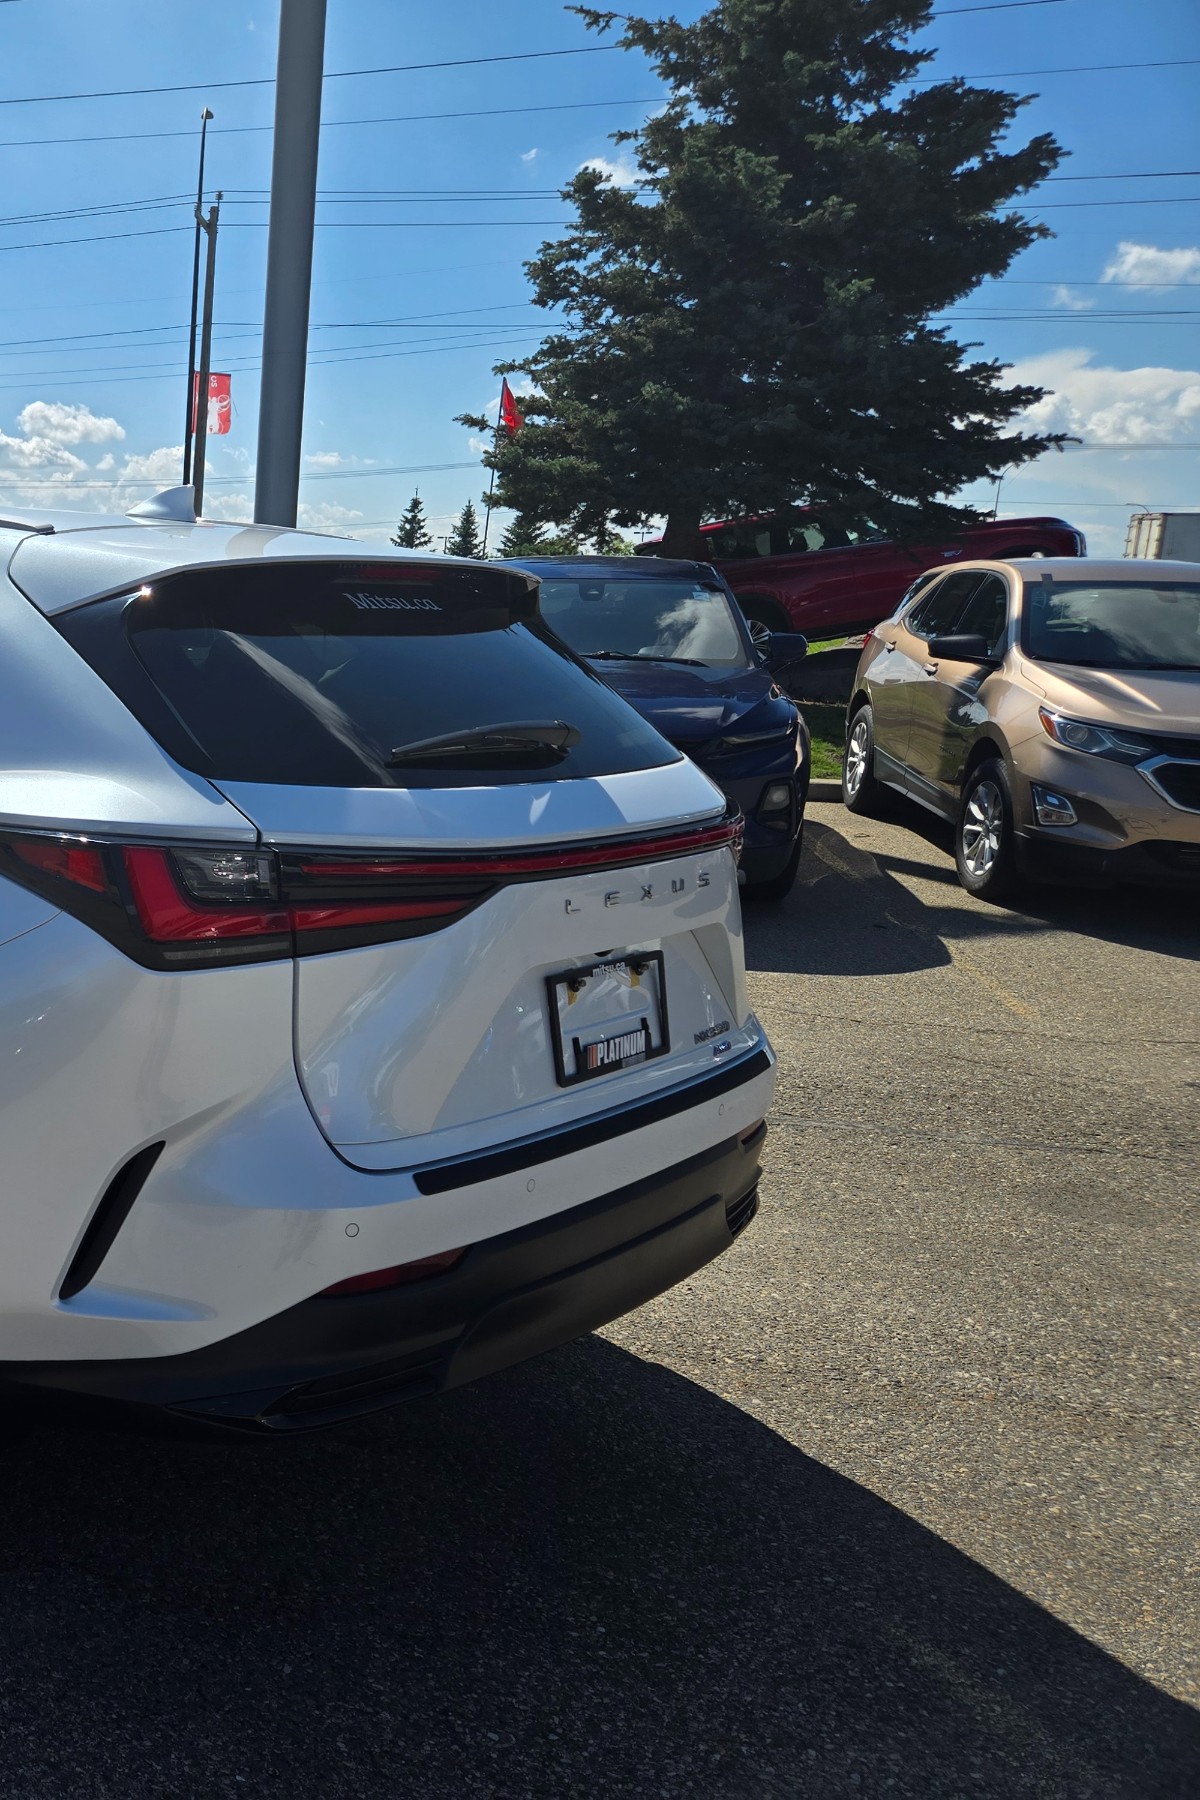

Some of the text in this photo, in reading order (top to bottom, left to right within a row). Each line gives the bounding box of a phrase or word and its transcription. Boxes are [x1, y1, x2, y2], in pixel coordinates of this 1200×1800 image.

[565, 872, 711, 915] LEXUS
[592, 961, 626, 977] mitsu.ca
[597, 1029, 646, 1067] PLATINUM
